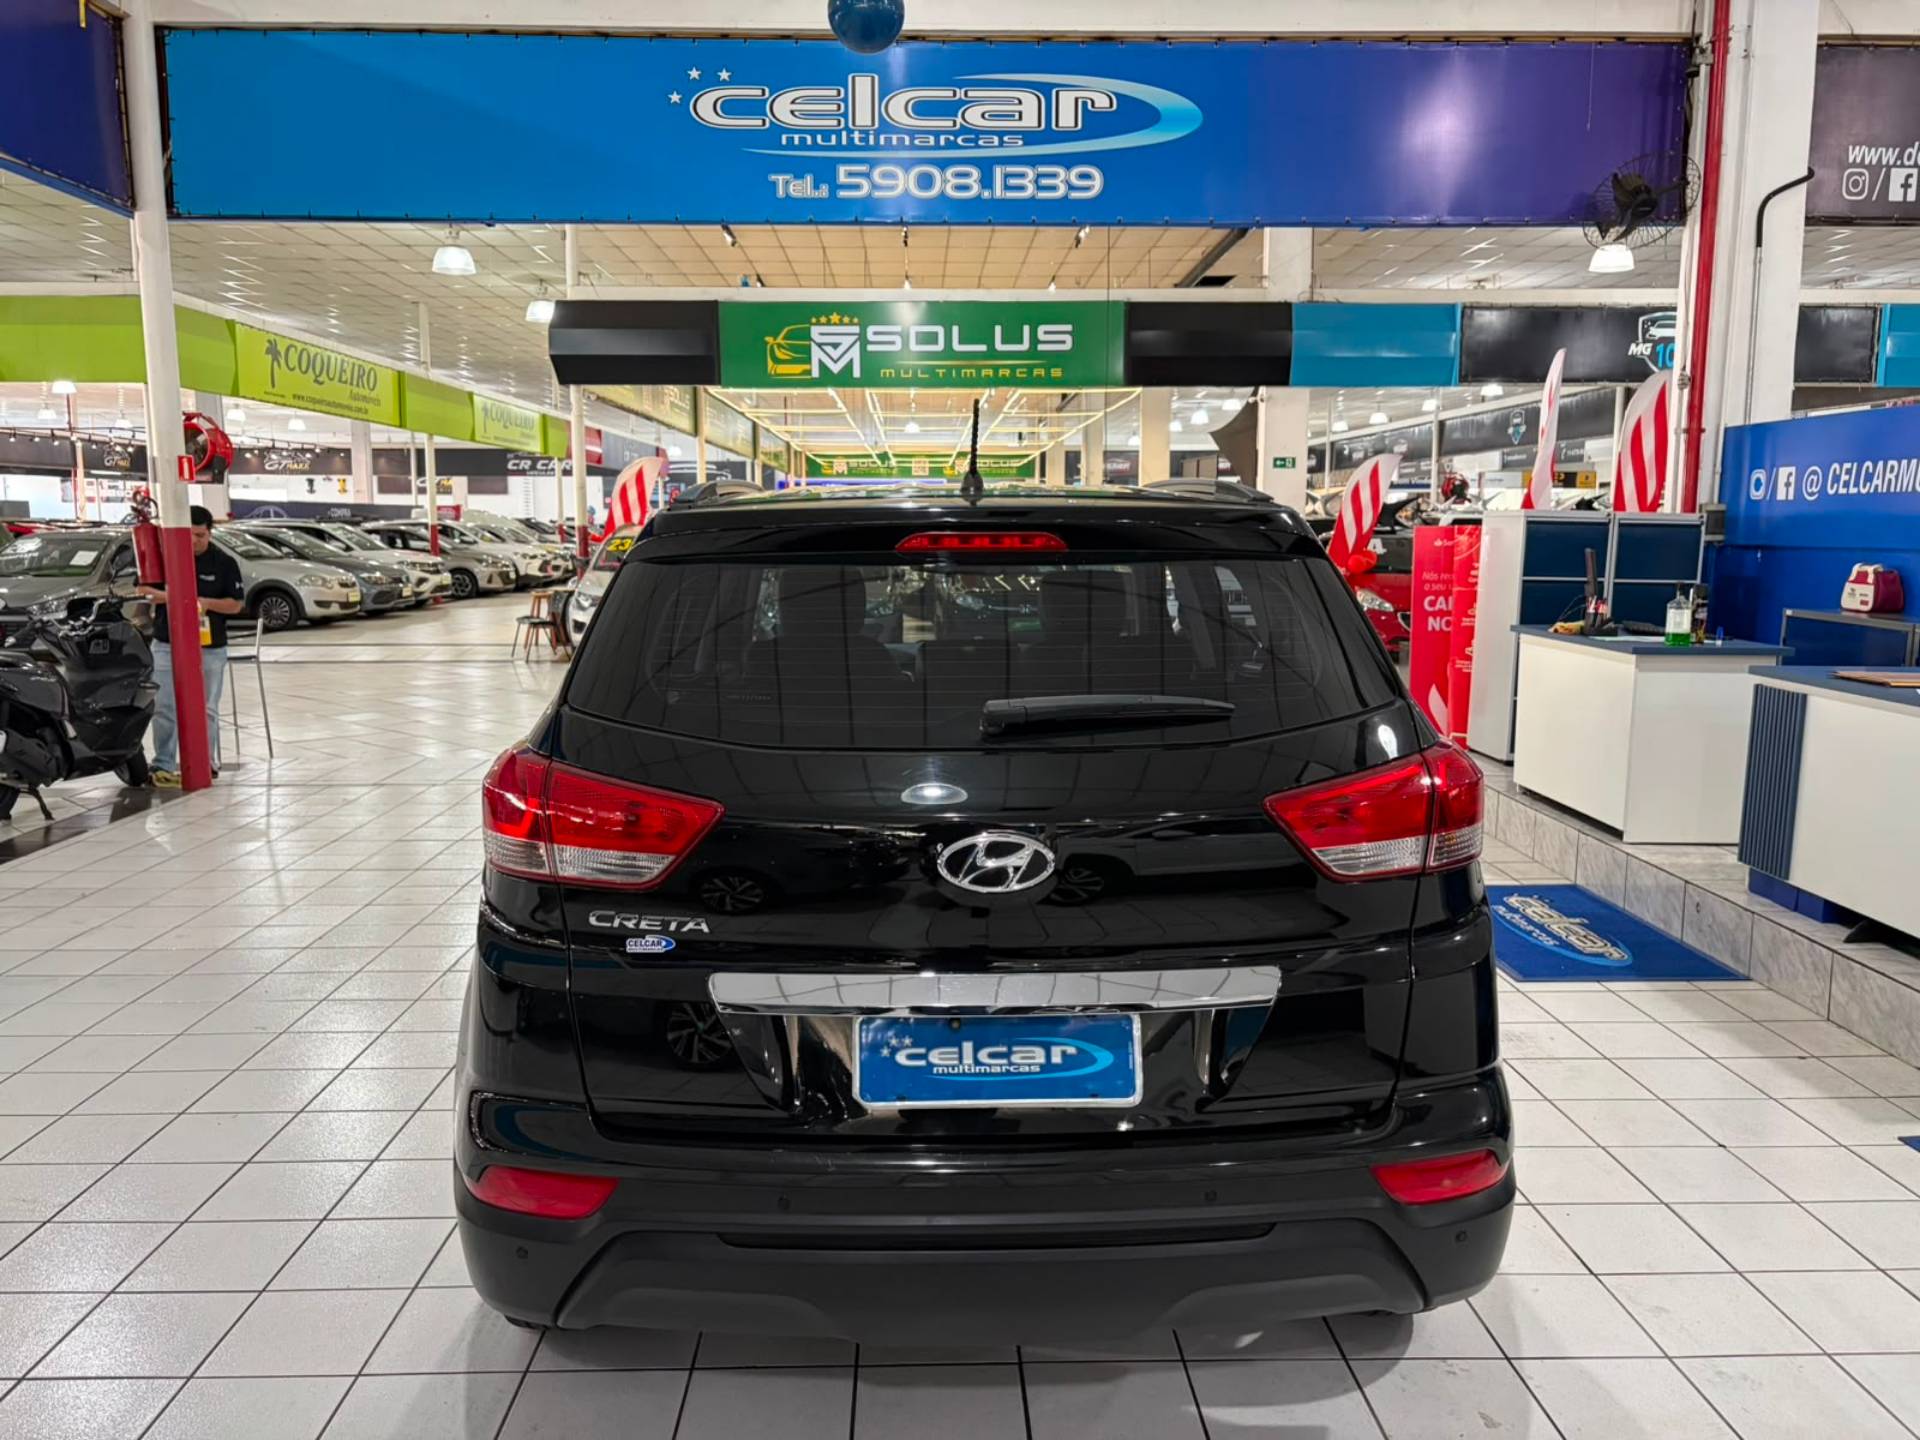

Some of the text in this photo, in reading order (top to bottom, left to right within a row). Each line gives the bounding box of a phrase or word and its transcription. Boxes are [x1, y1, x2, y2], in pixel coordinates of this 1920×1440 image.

[689, 74, 1117, 131] celcar
[781, 131, 1024, 148] multimarcas
[836, 163, 1105, 200] 5908.1339
[866, 324, 1073, 351] SOLUS
[1628, 342, 1653, 356] MG
[283, 344, 377, 392] COQUEIRO
[879, 368, 1065, 378] MULTIMARCAS
[507, 459, 533, 470] CR
[607, 538, 634, 552] 23
[588, 910, 711, 933] CRETA
[627, 938, 663, 948] CELCAR
[894, 1041, 1078, 1067] celcar
[933, 1063, 1042, 1075] multimarcas
